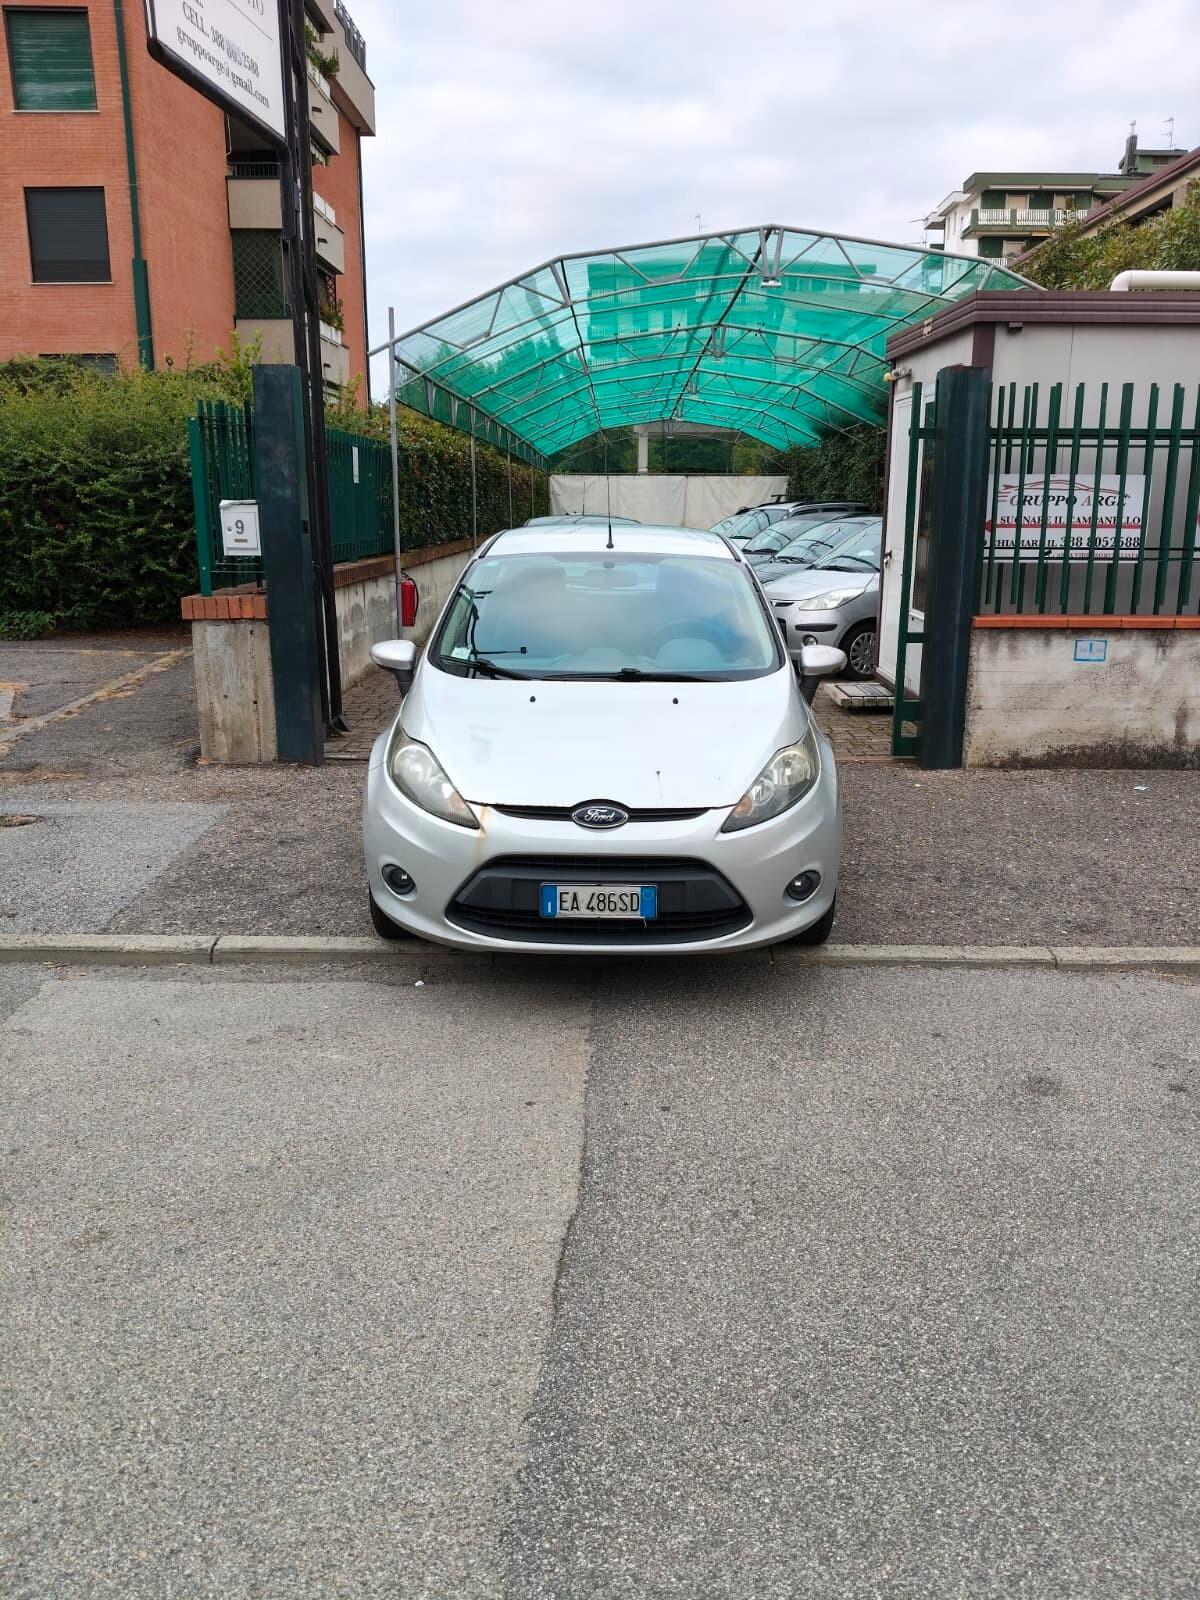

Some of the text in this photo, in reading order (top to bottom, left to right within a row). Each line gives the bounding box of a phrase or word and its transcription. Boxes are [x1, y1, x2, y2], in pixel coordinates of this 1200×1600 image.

[235, 519, 244, 535] 9
[584, 808, 616, 822] Ford
[559, 891, 580, 912] EA
[586, 891, 640, 912] 486SD
